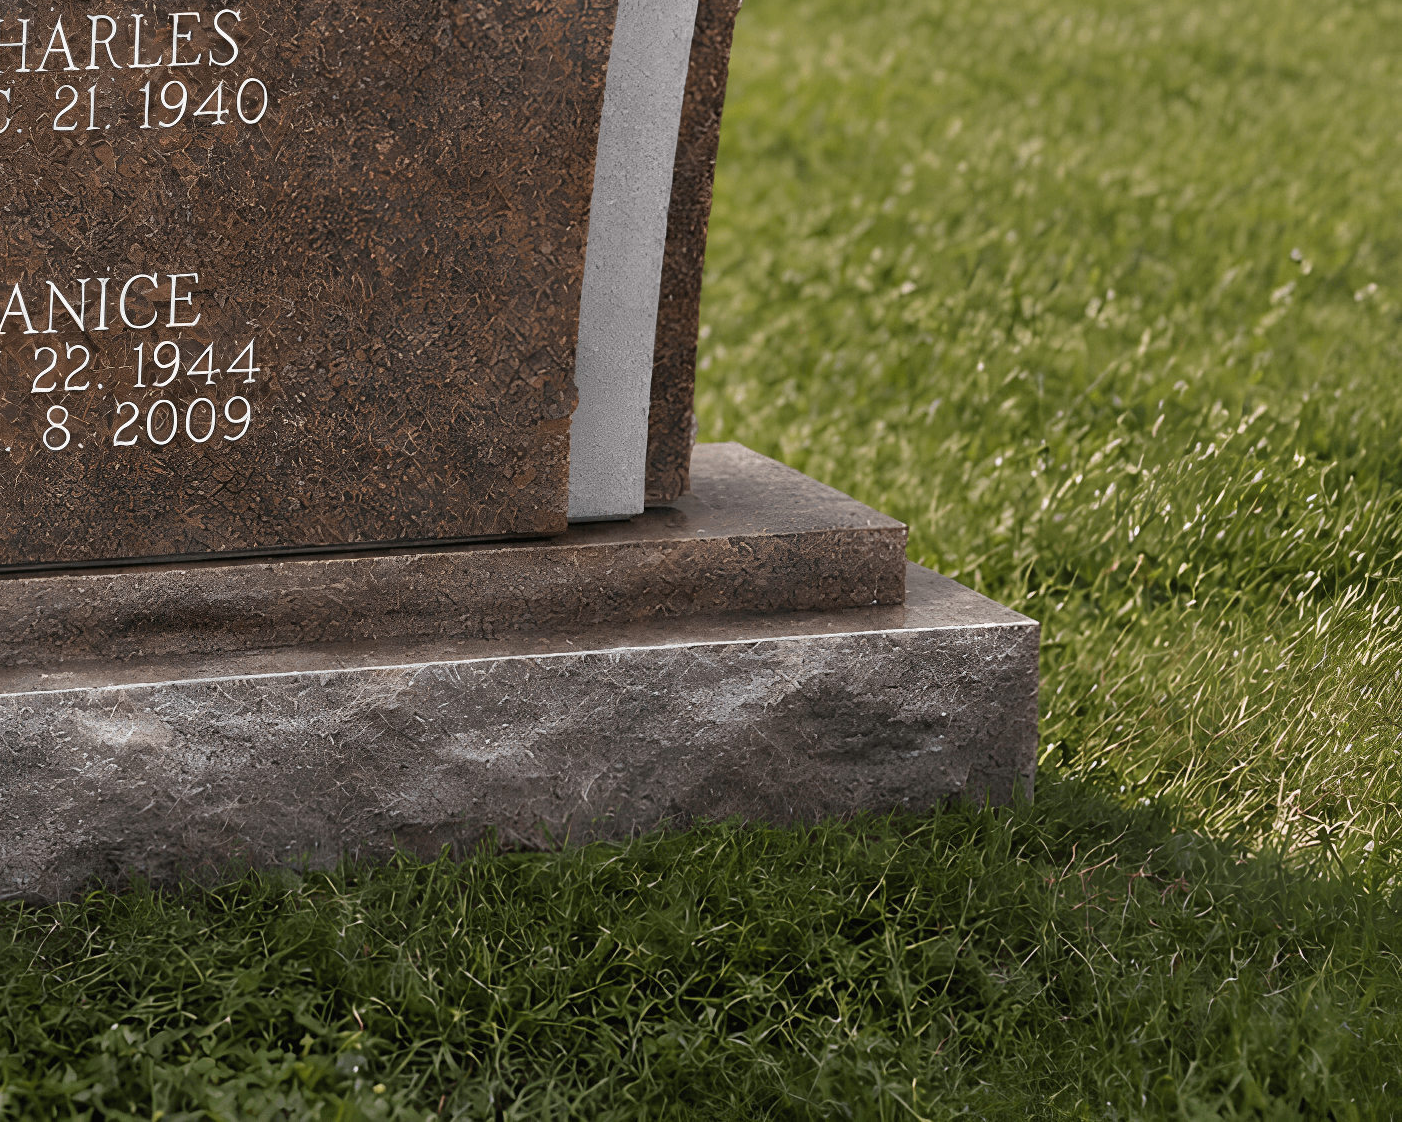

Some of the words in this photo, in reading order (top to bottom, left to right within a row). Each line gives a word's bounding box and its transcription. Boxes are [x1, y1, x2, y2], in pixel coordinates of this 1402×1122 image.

[139, 78, 268, 129] 1940
[30, 342, 104, 394] 22.
[132, 337, 261, 388] 1944
[42, 404, 85, 451] 8.
[113, 395, 252, 447] 2009
